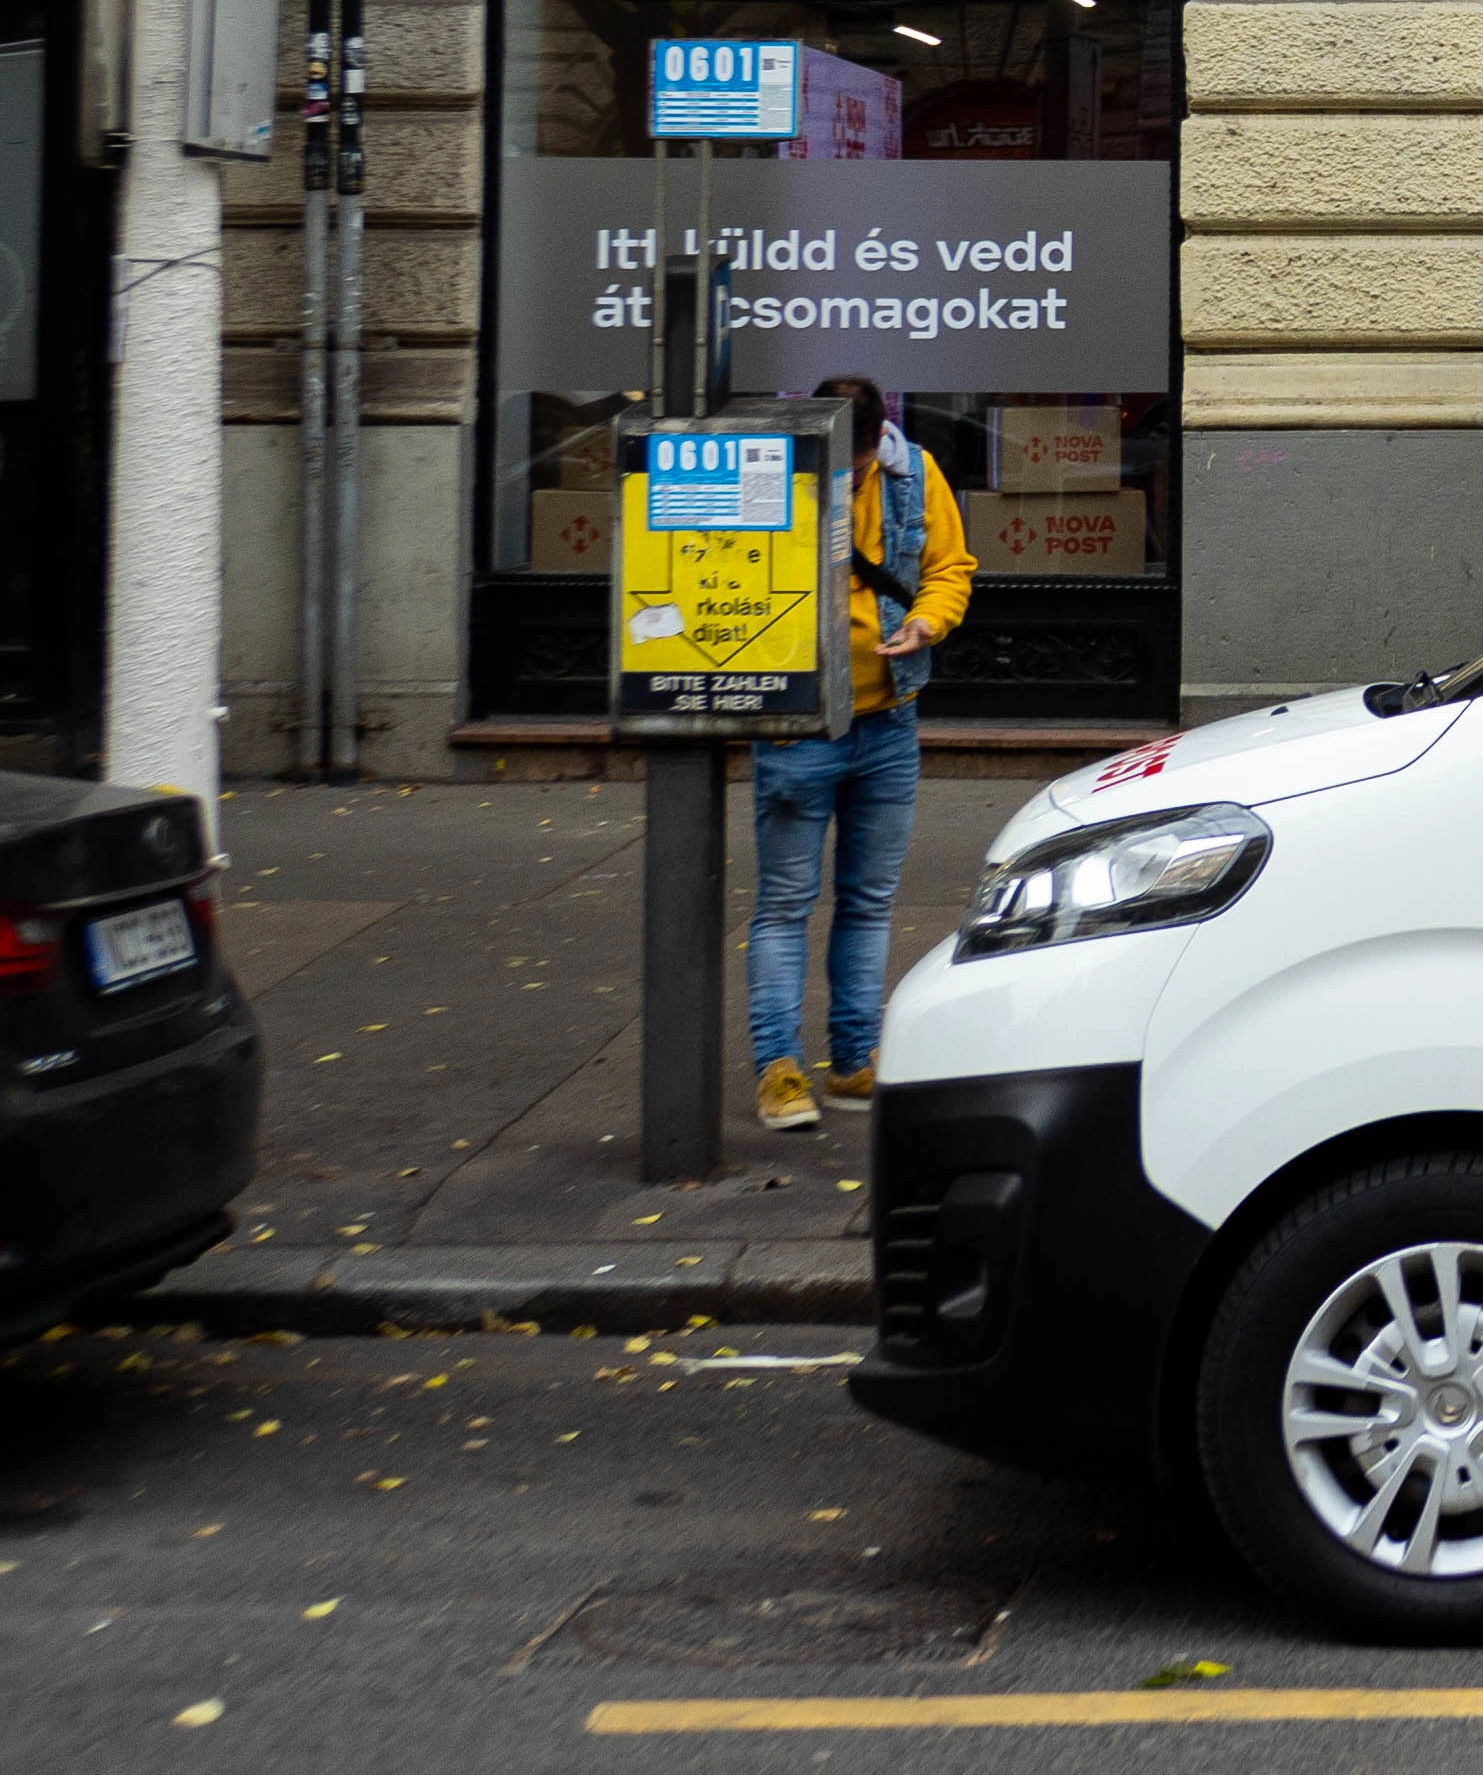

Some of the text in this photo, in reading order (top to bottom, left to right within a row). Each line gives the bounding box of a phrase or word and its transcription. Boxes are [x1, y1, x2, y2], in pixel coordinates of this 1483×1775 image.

[664, 45, 753, 82] 0601
[854, 227, 920, 272] és
[935, 230, 1074, 273] vedd
[592, 283, 1067, 340] át csomagokat
[1055, 436, 1104, 449] NOVA
[657, 439, 738, 471] 0601
[1055, 450, 1103, 463] POST
[1045, 515, 1117, 534] NOVA
[1045, 536, 1113, 554] POST
[649, 675, 788, 692] BITTE ZAHLEN
[671, 695, 709, 712] SIE
